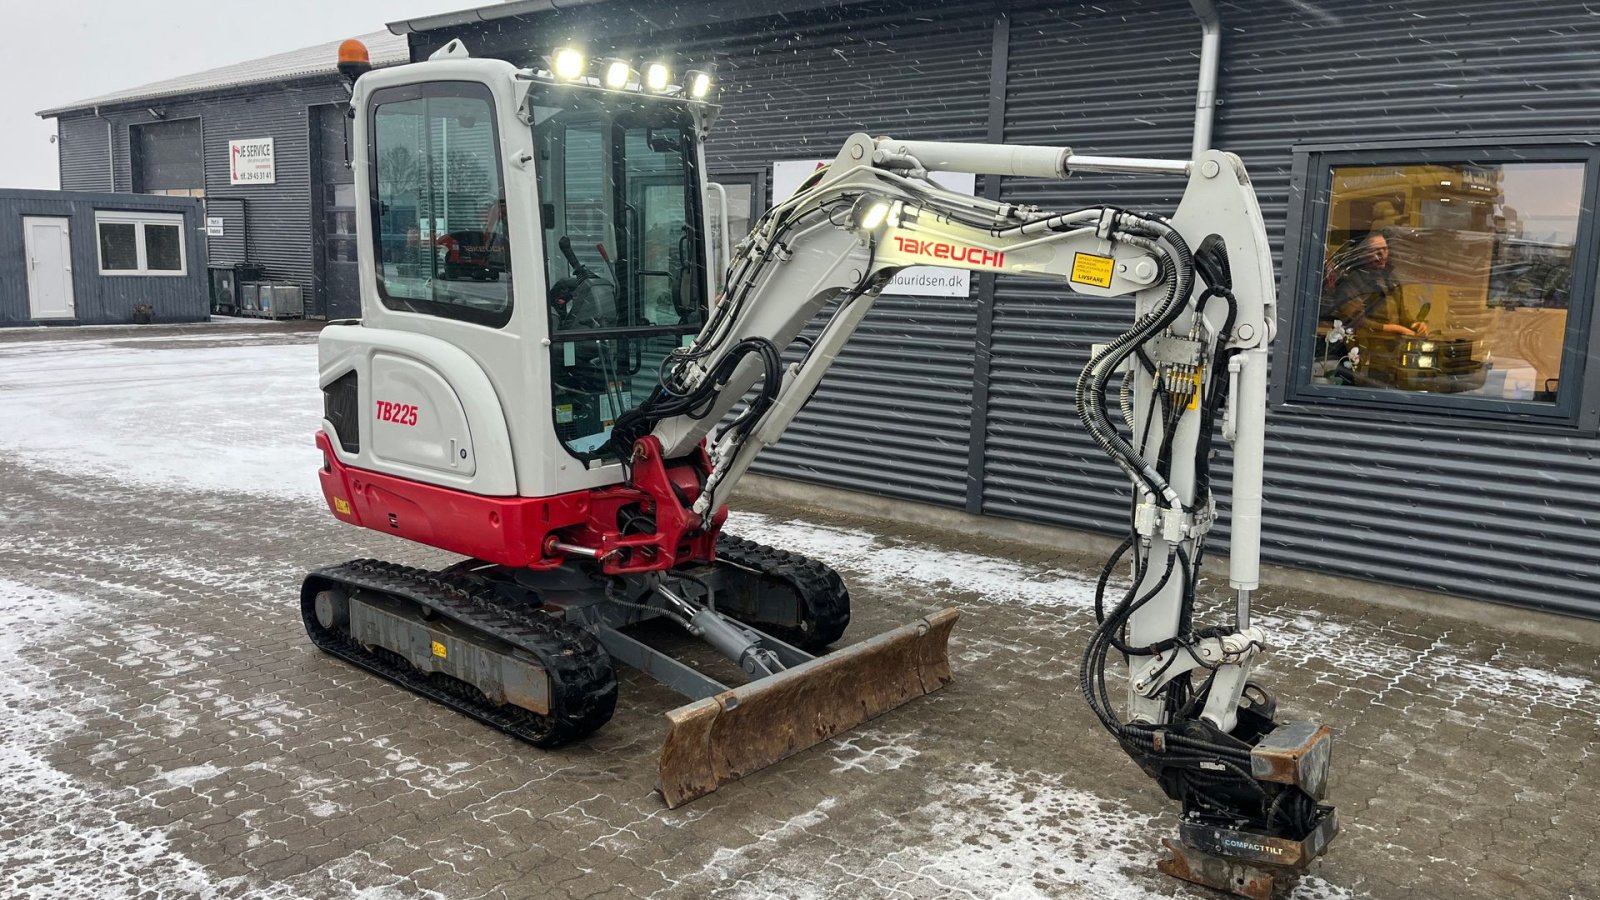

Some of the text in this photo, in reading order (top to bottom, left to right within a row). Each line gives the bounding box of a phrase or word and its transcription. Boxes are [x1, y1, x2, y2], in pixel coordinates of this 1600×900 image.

[240, 144, 271, 157] JE SERVICE
[894, 236, 1004, 268] TAKEUCHI
[1078, 273, 1104, 283] LIVSFARE
[376, 400, 419, 426] TB225
